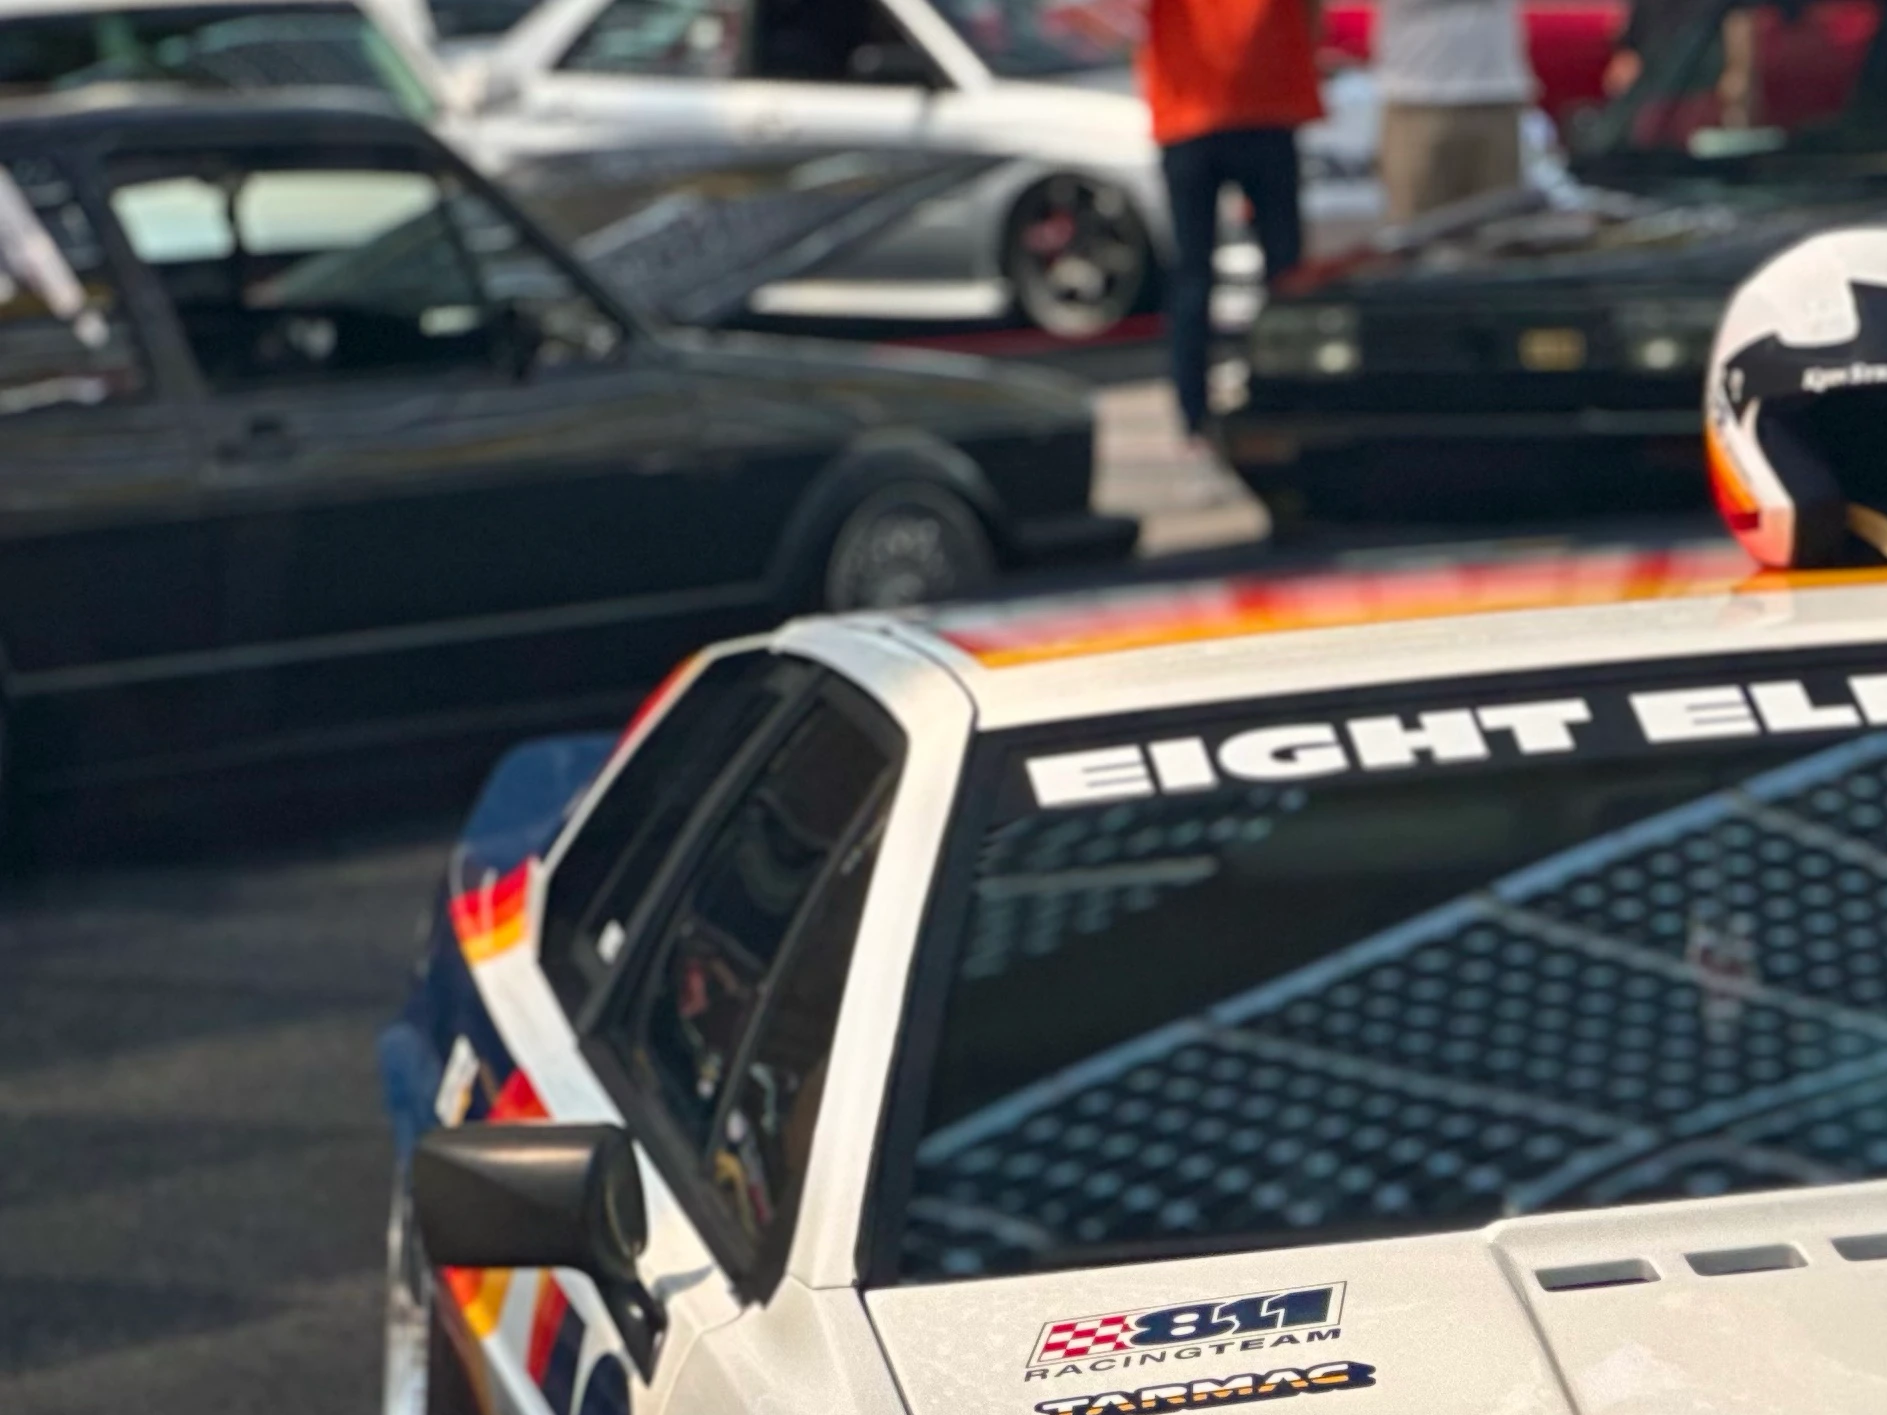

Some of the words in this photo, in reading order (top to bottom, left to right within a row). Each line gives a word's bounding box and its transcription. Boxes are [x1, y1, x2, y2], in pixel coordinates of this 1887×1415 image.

[1024, 699, 1593, 807] EIGHT
[1130, 1286, 1334, 1346] 811
[1024, 1328, 1342, 1382] RACINGTEAM
